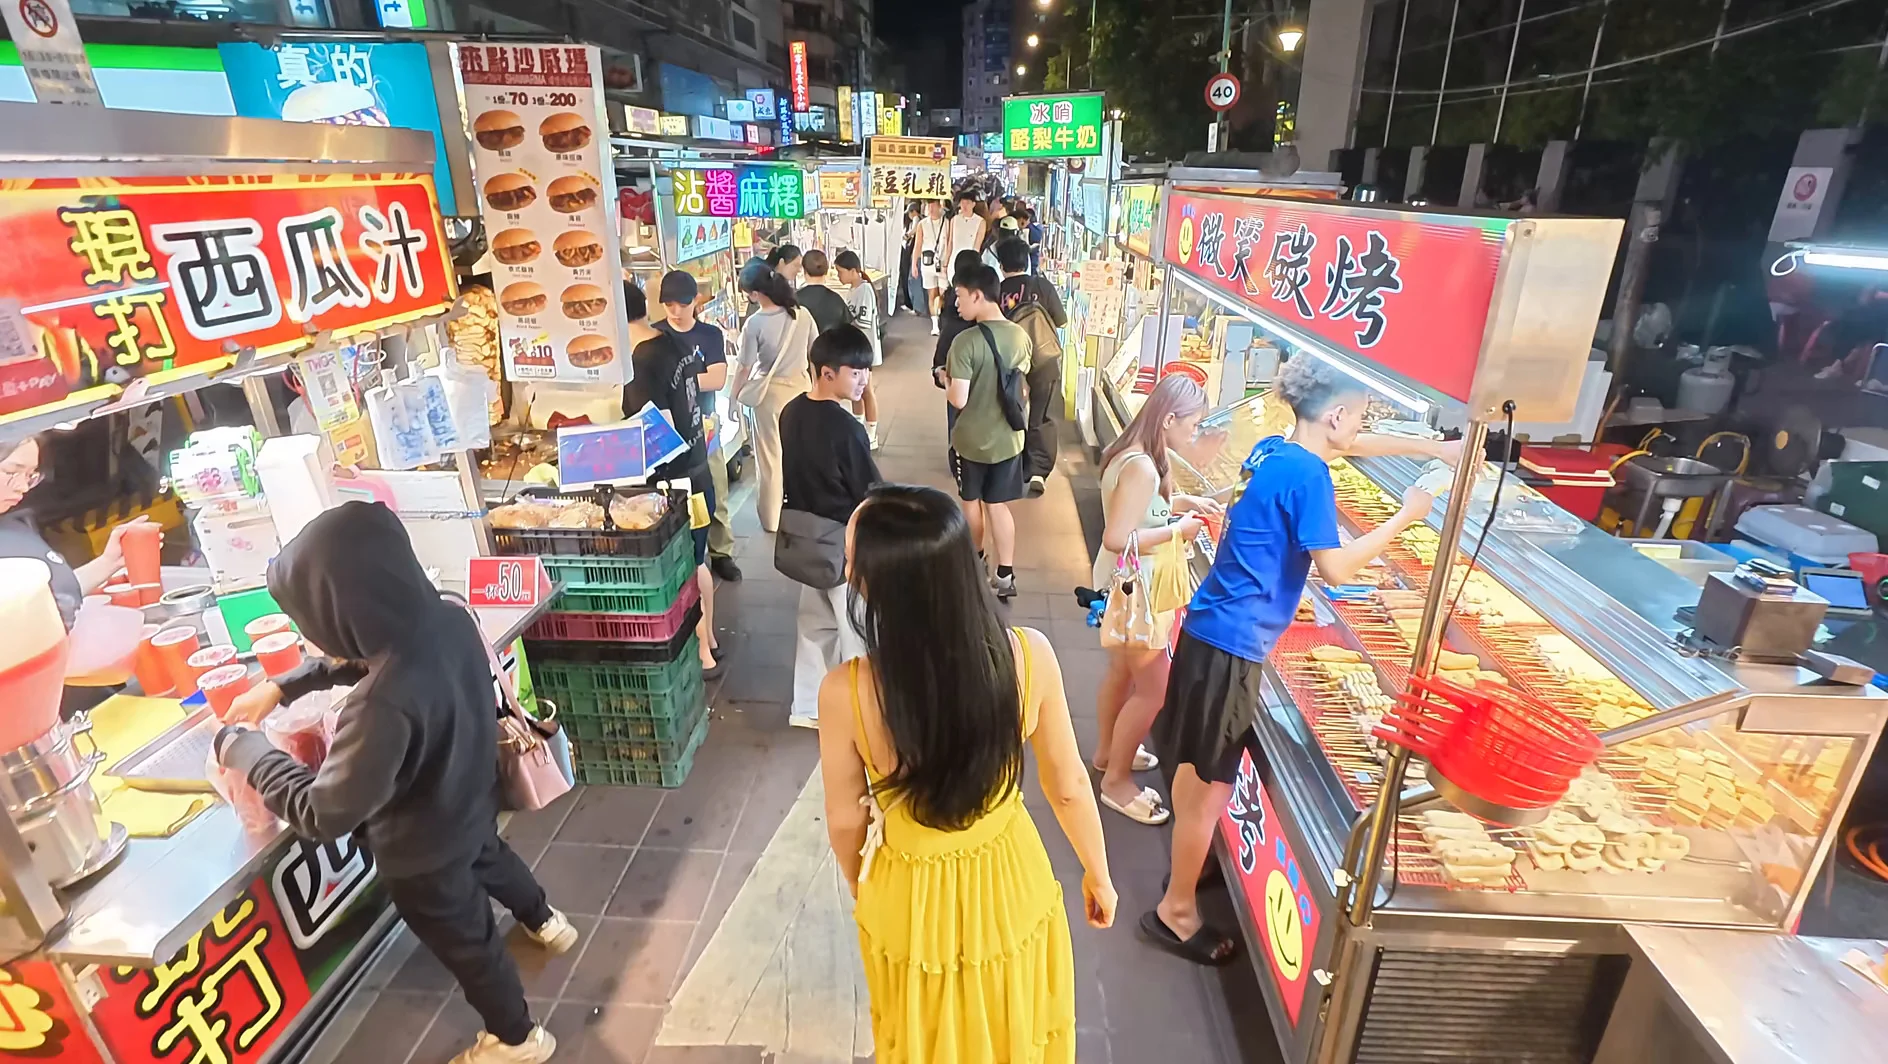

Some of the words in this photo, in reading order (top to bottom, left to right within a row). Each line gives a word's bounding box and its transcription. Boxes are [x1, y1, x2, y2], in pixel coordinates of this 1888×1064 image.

[276, 43, 373, 88] 真的
[460, 46, 588, 74] 來點沙威瑪
[1212, 86, 1233, 98] 40
[1030, 101, 1073, 124] 冰哨
[1010, 125, 1097, 151] 酪梨牛奶
[674, 169, 800, 217] 沾醬麻糬
[884, 170, 947, 196] 豆乳雞
[60, 207, 175, 366] 現打
[152, 203, 427, 338] 西瓜汁
[1197, 212, 1403, 348] 微笑碳烤
